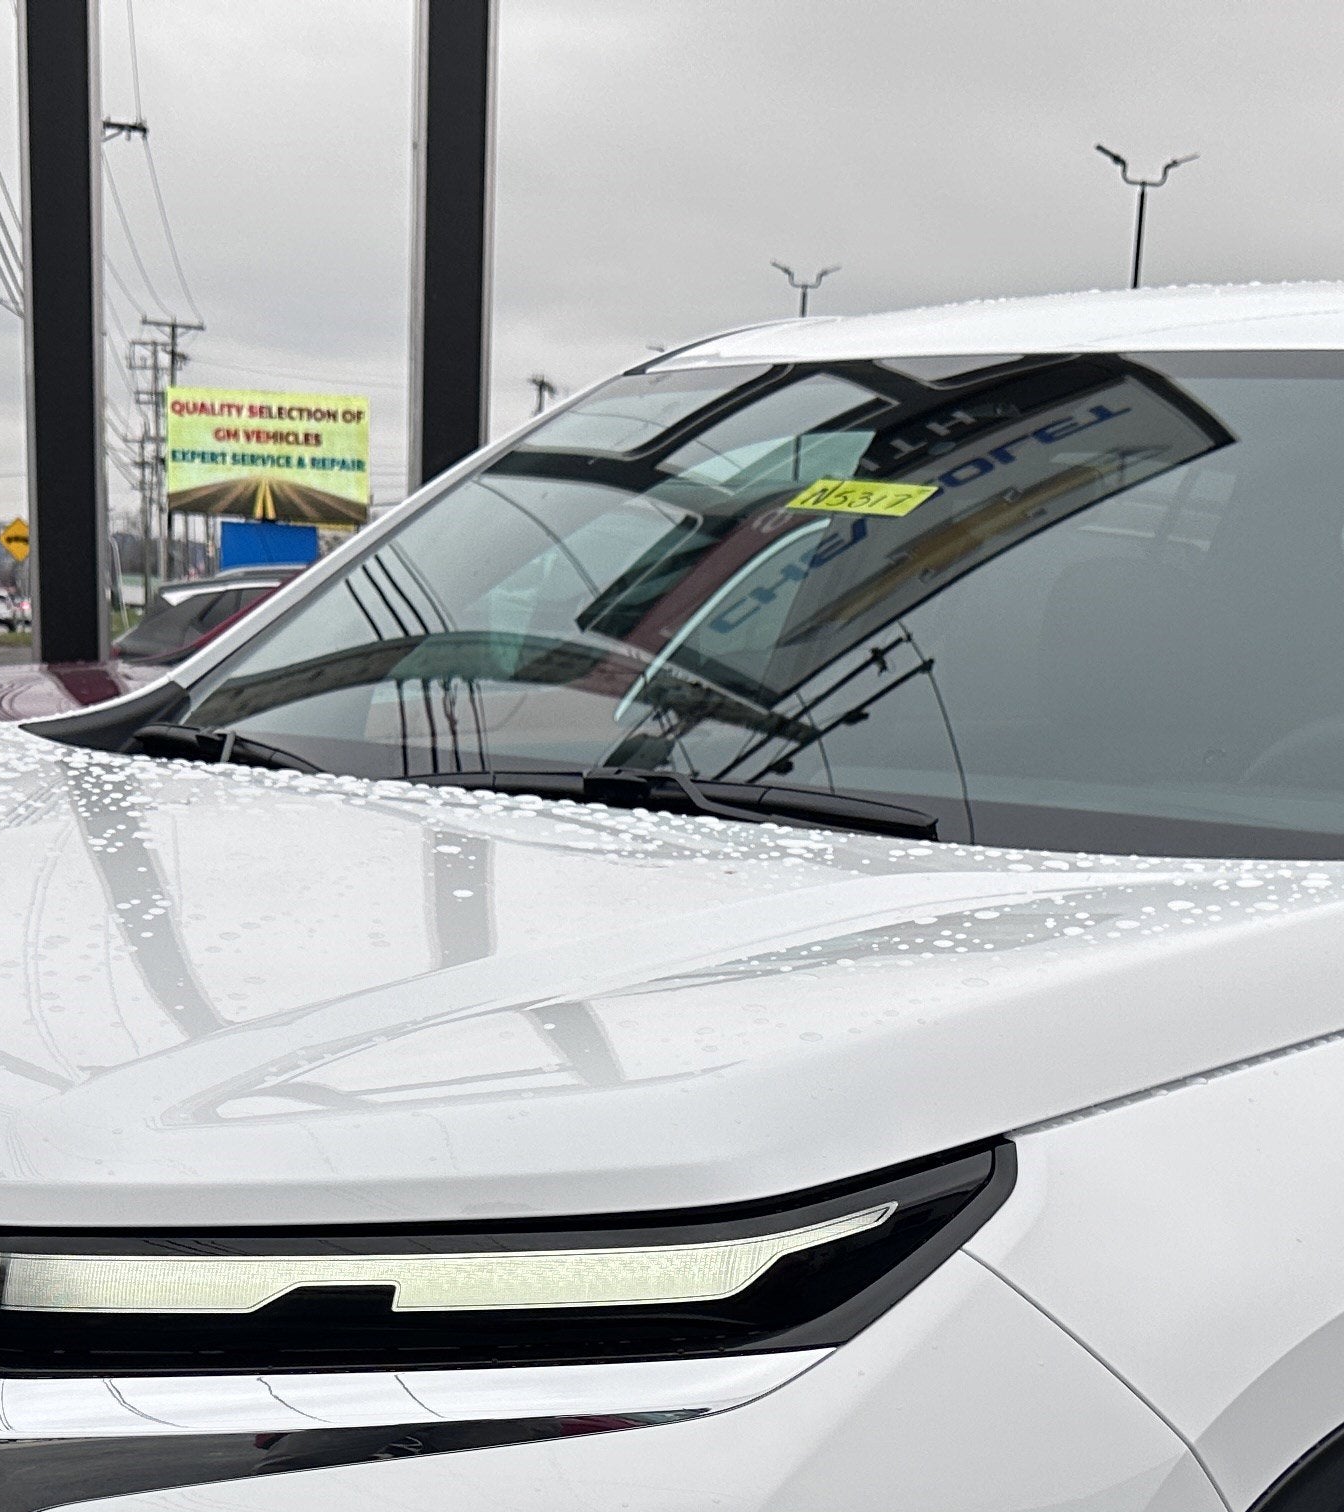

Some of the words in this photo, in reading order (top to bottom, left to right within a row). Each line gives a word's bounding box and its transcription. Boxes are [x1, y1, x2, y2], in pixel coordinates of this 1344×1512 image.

[171, 400, 243, 418] QUALITY
[248, 405, 338, 422] SELECTION
[341, 409, 365, 424] OF
[214, 427, 239, 443] GM
[242, 429, 322, 447] VEHICLES
[171, 449, 227, 465] EXPERT
[231, 452, 293, 468] SERVICE
[297, 455, 307, 470] &
[311, 456, 366, 473] REPAIR
